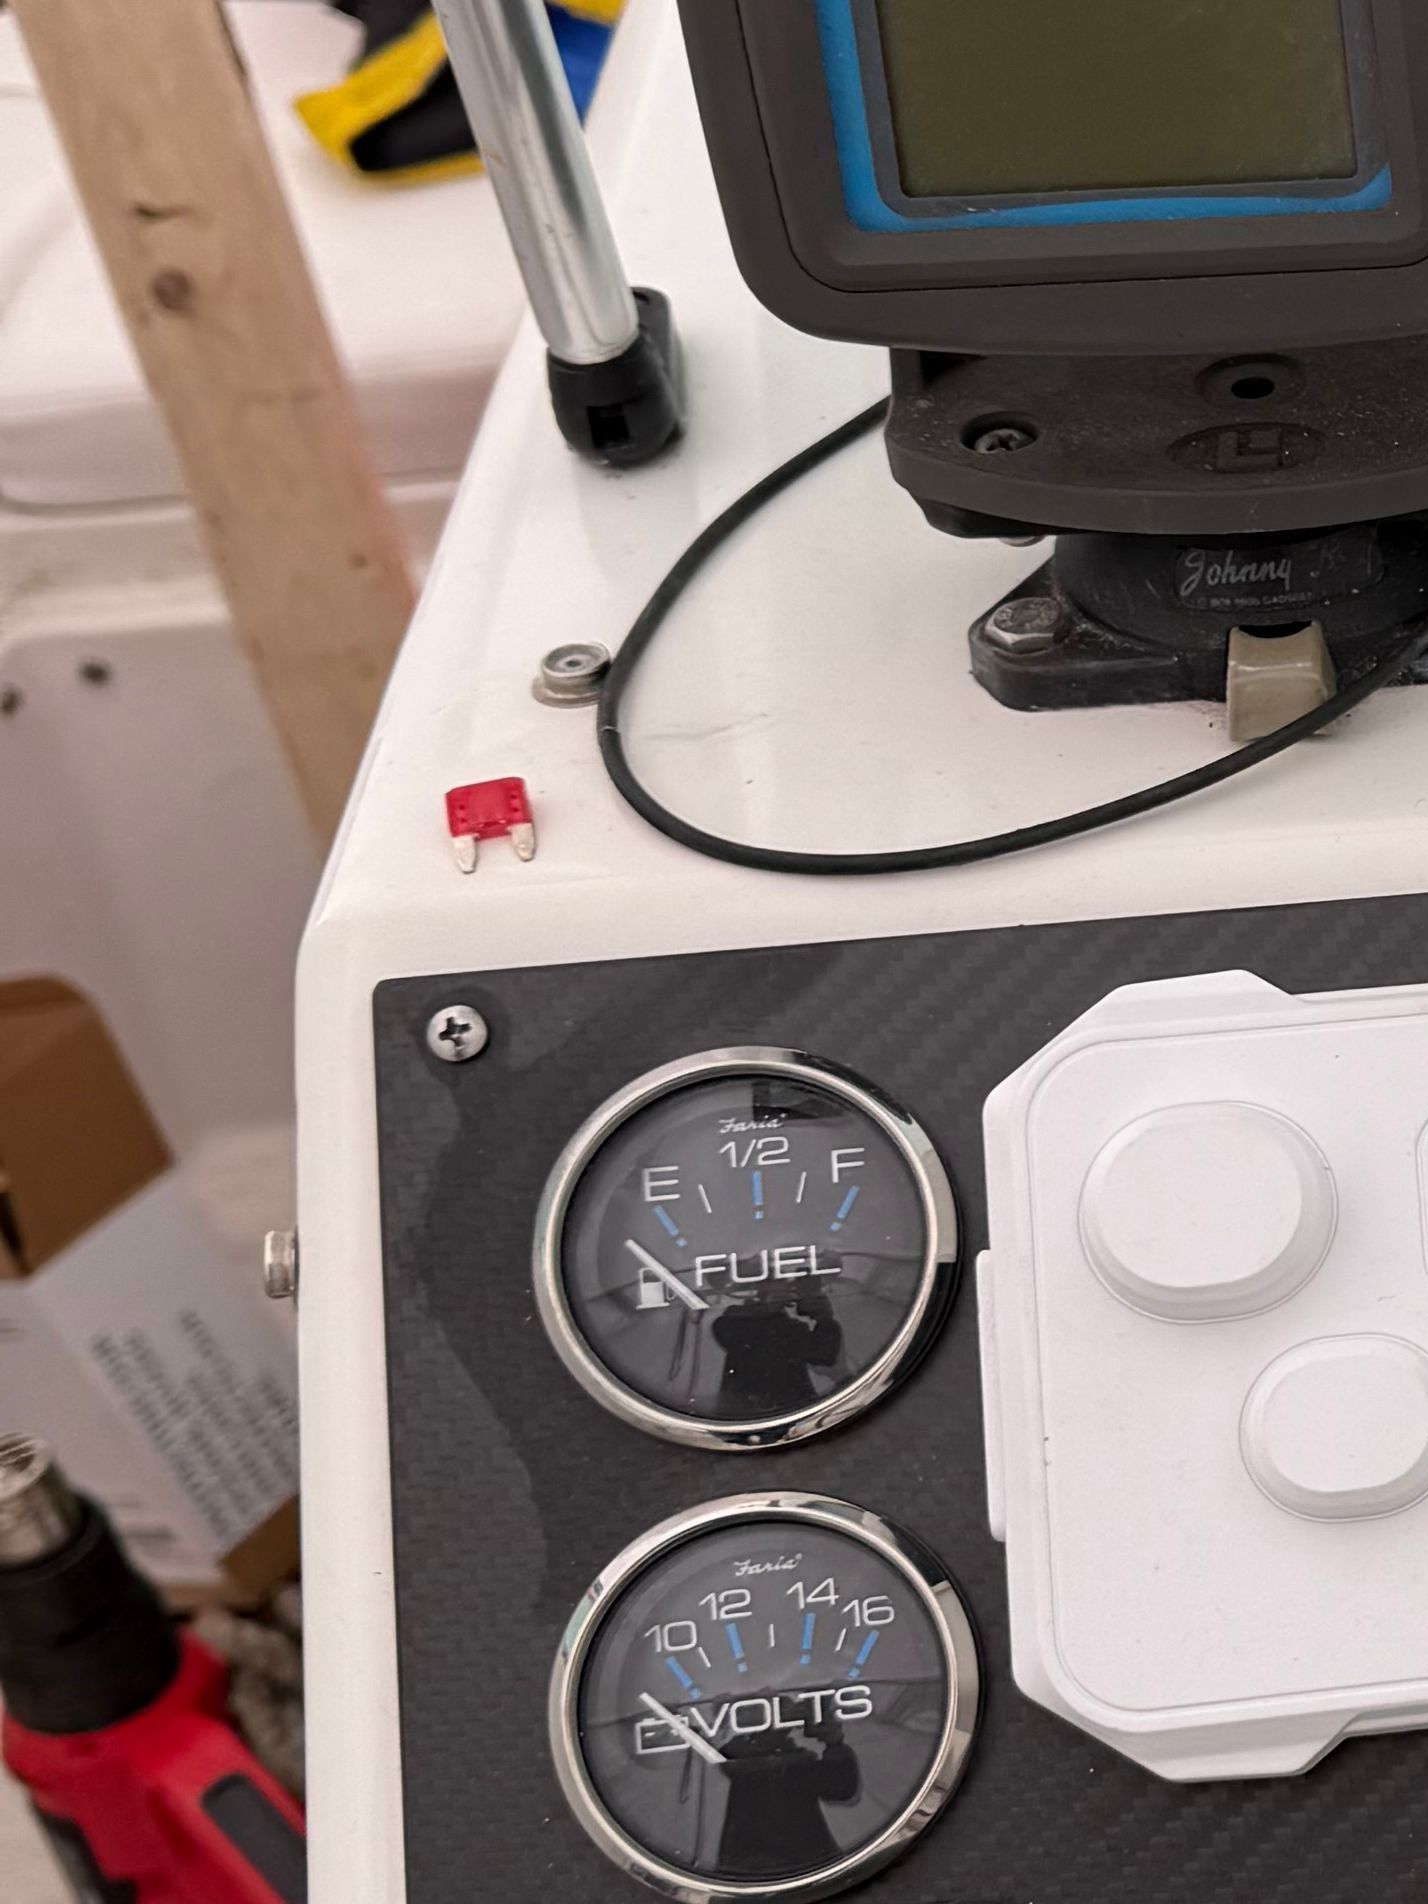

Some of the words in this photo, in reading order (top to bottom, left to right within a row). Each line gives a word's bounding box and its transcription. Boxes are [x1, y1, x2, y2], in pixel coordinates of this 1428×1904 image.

[1179, 548, 1292, 592] Johnny
[644, 1166, 680, 1202] E
[719, 1137, 790, 1169] 1/2
[831, 1148, 865, 1183] F
[695, 1245, 841, 1288] FUEL
[644, 1621, 697, 1653] 10
[699, 1588, 752, 1621] 12
[786, 1577, 839, 1609] 14
[842, 1596, 895, 1627] 16
[690, 1685, 872, 1738] VOLTS
